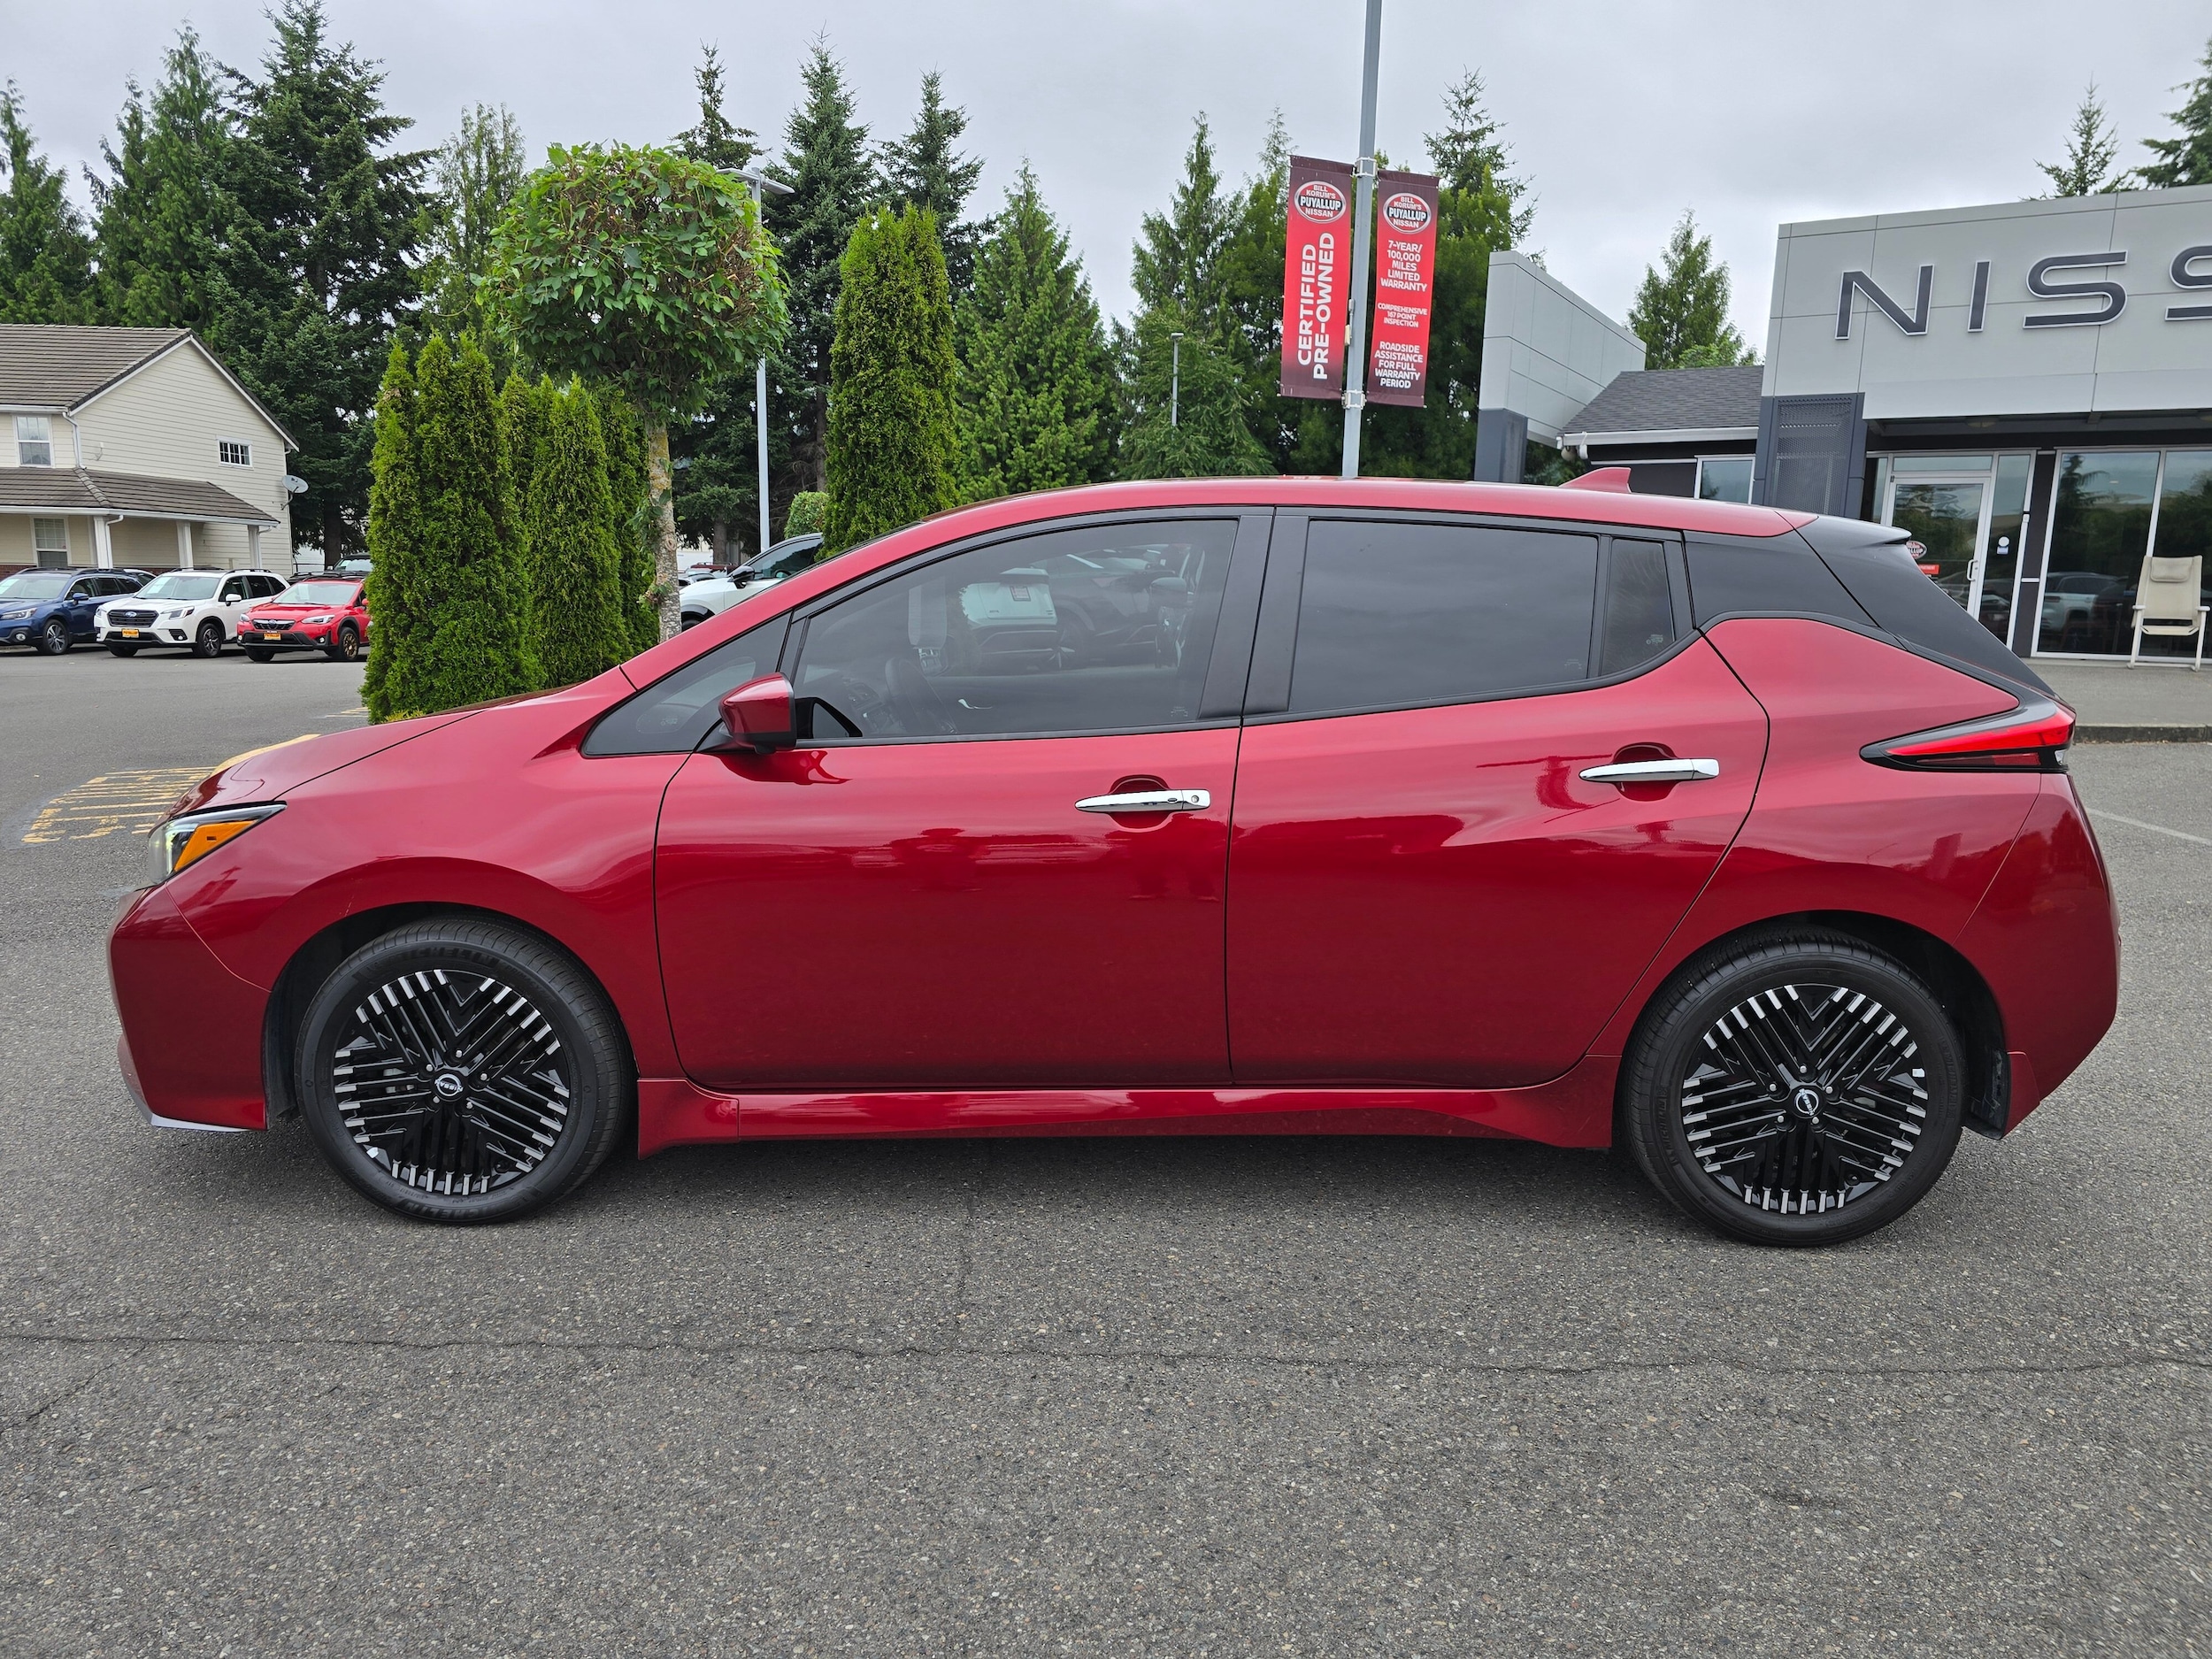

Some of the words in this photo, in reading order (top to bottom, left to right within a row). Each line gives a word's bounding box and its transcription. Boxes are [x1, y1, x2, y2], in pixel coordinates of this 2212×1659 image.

[1306, 189, 1336, 199] KORUM'S
[1301, 196, 1341, 211] PUYALLUP
[1305, 208, 1333, 217] NISSAN
[1389, 207, 1426, 221] PUYALLUP
[1393, 219, 1419, 228] NISSAN
[1388, 239, 1423, 253] 7-YEAR/
[1387, 250, 1421, 263] 100,000
[1392, 259, 1417, 272] MILES
[1387, 268, 1421, 281] LIMITED
[1380, 277, 1427, 292] WARRANTY
[1297, 243, 1317, 365] CERTIFIED
[1313, 232, 1335, 380] PRE-OWNED
[1378, 302, 1427, 315] COMPREHENSIVE
[1383, 317, 1419, 327] INSPECTION
[1379, 341, 1420, 354] ROADSIDE
[1374, 349, 1424, 363] ASSISTANCE
[1379, 359, 1395, 369] FOR
[1395, 361, 1417, 371] FULL
[1374, 368, 1421, 380] WARRANTY
[1380, 378, 1412, 388] PERIOD
